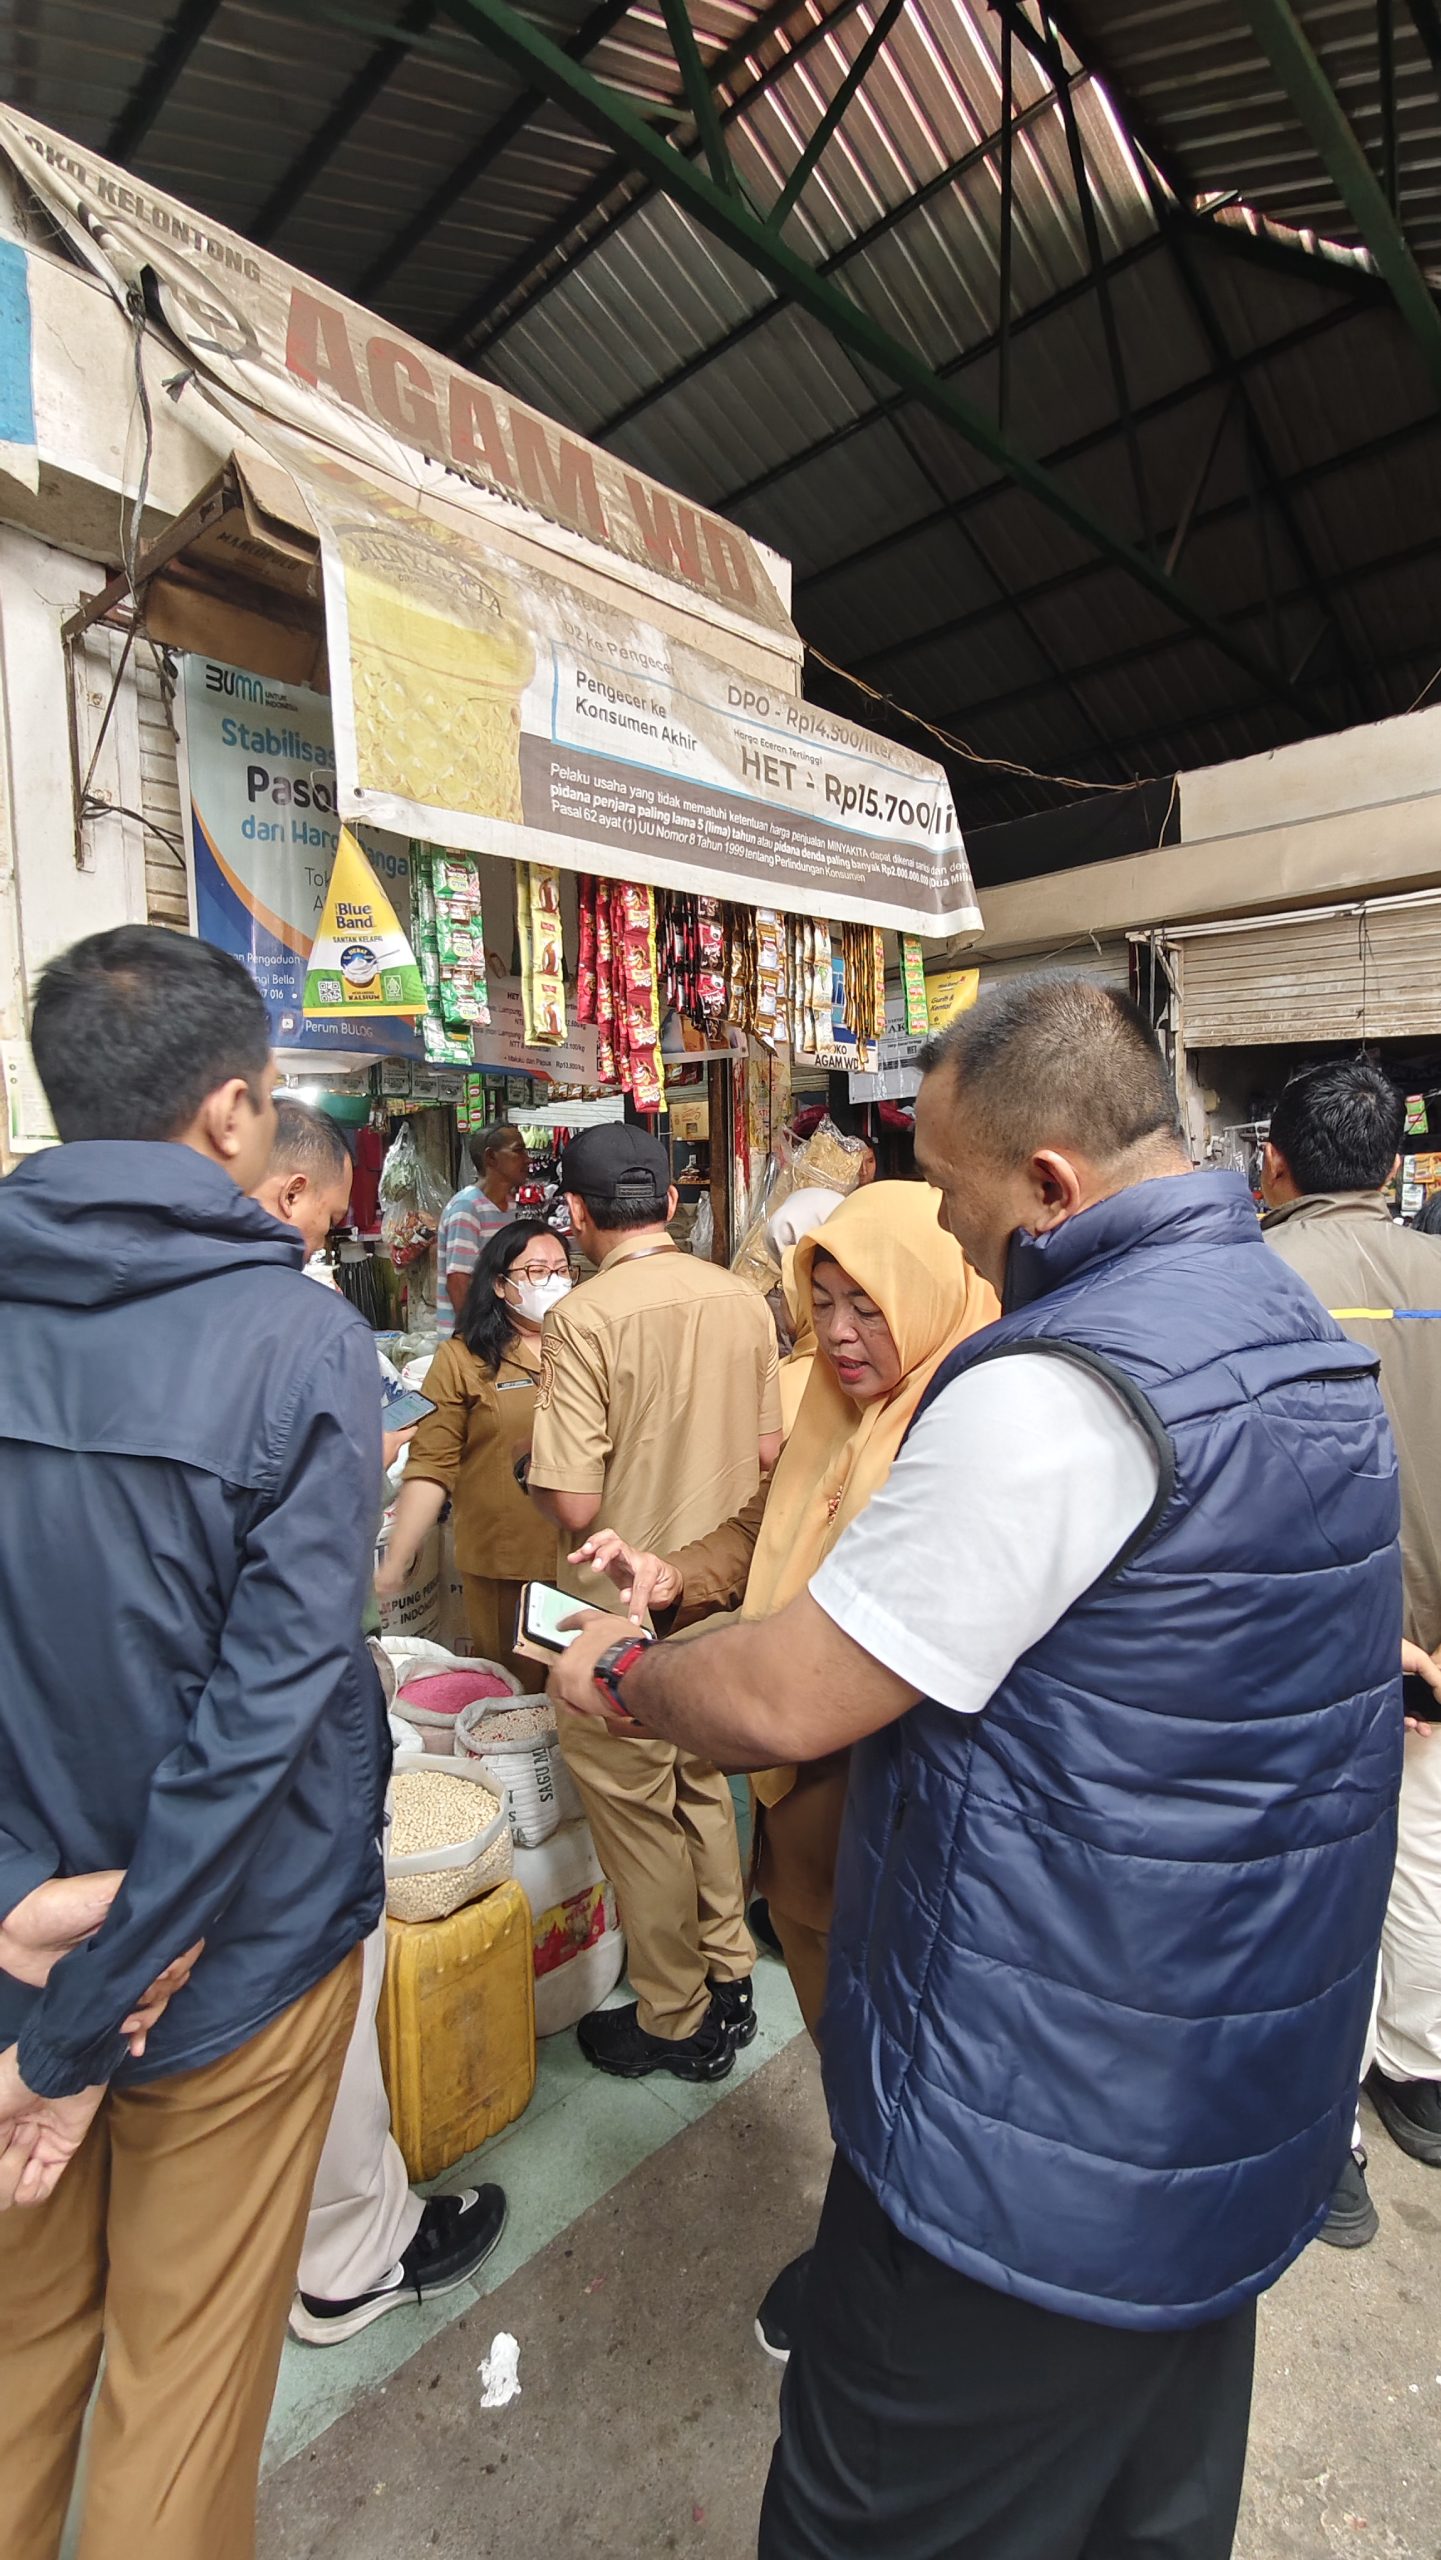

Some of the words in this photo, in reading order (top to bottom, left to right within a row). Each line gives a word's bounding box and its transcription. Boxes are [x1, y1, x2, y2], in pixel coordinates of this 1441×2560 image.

[98, 176, 261, 284] KELONTONG
[285, 287, 609, 538] AGAM
[624, 474, 758, 608] WD
[606, 641, 676, 676] Pengecer
[576, 670, 647, 709] Pengecer
[651, 698, 667, 719] ke
[728, 685, 770, 717] DPO
[575, 696, 658, 738] Konsumen
[661, 726, 698, 752] Akhir
[733, 728, 759, 745] Harga
[760, 738, 788, 755] Eceran
[788, 747, 823, 766] Tertinggi
[741, 745, 797, 791] HET
[824, 773, 959, 835] Rp15.700/li
[550, 763, 590, 785] Pelaku
[593, 776, 627, 794] usaha
[629, 784, 655, 804] yang
[657, 791, 681, 809] tidak
[683, 801, 728, 820] mematuhi
[728, 810, 769, 831] ketentuan
[769, 822, 791, 839] harga
[791, 831, 826, 848] penjualan
[827, 840, 869, 859] MINYAKITA
[869, 851, 891, 863] dapat
[550, 784, 591, 804] pidana
[592, 794, 636, 815] penjara
[637, 805, 670, 825] paling
[671, 811, 696, 829] lama
[697, 818, 704, 831] 5
[704, 820, 731, 840] (lima)
[732, 826, 756, 845] tahun
[774, 841, 800, 857] pidana
[801, 848, 826, 863] denda
[826, 853, 851, 870] paling
[851, 858, 880, 874] banyak
[241, 815, 285, 842] dan
[290, 818, 340, 858] Harg
[551, 800, 583, 819] Pasal
[583, 807, 597, 823] 62
[598, 813, 622, 830] ayat
[622, 817, 638, 836] (1)
[638, 821, 655, 836] UU
[656, 826, 688, 845] Nomor
[688, 833, 695, 845] 8
[697, 835, 723, 852] Tahun
[724, 842, 745, 858] 1999
[774, 852, 825, 876] Perlindungan
[825, 865, 866, 883] Konsumen
[304, 866, 332, 888] Tok
[335, 915, 374, 929] Band
[337, 903, 373, 915] Blue
[247, 952, 300, 967] Pengaduan
[270, 990, 284, 1000] 016
[272, 974, 295, 985] Bella
[507, 991, 520, 1001] HET
[305, 1019, 339, 1035] Perum
[341, 1021, 374, 1038] BULOG
[815, 1055, 844, 1068] AGAM
[844, 1058, 859, 1071] WD
[833, 1044, 848, 1054] OKO
[532, 1747, 550, 1765] M
[534, 1766, 554, 1803] SAGU
